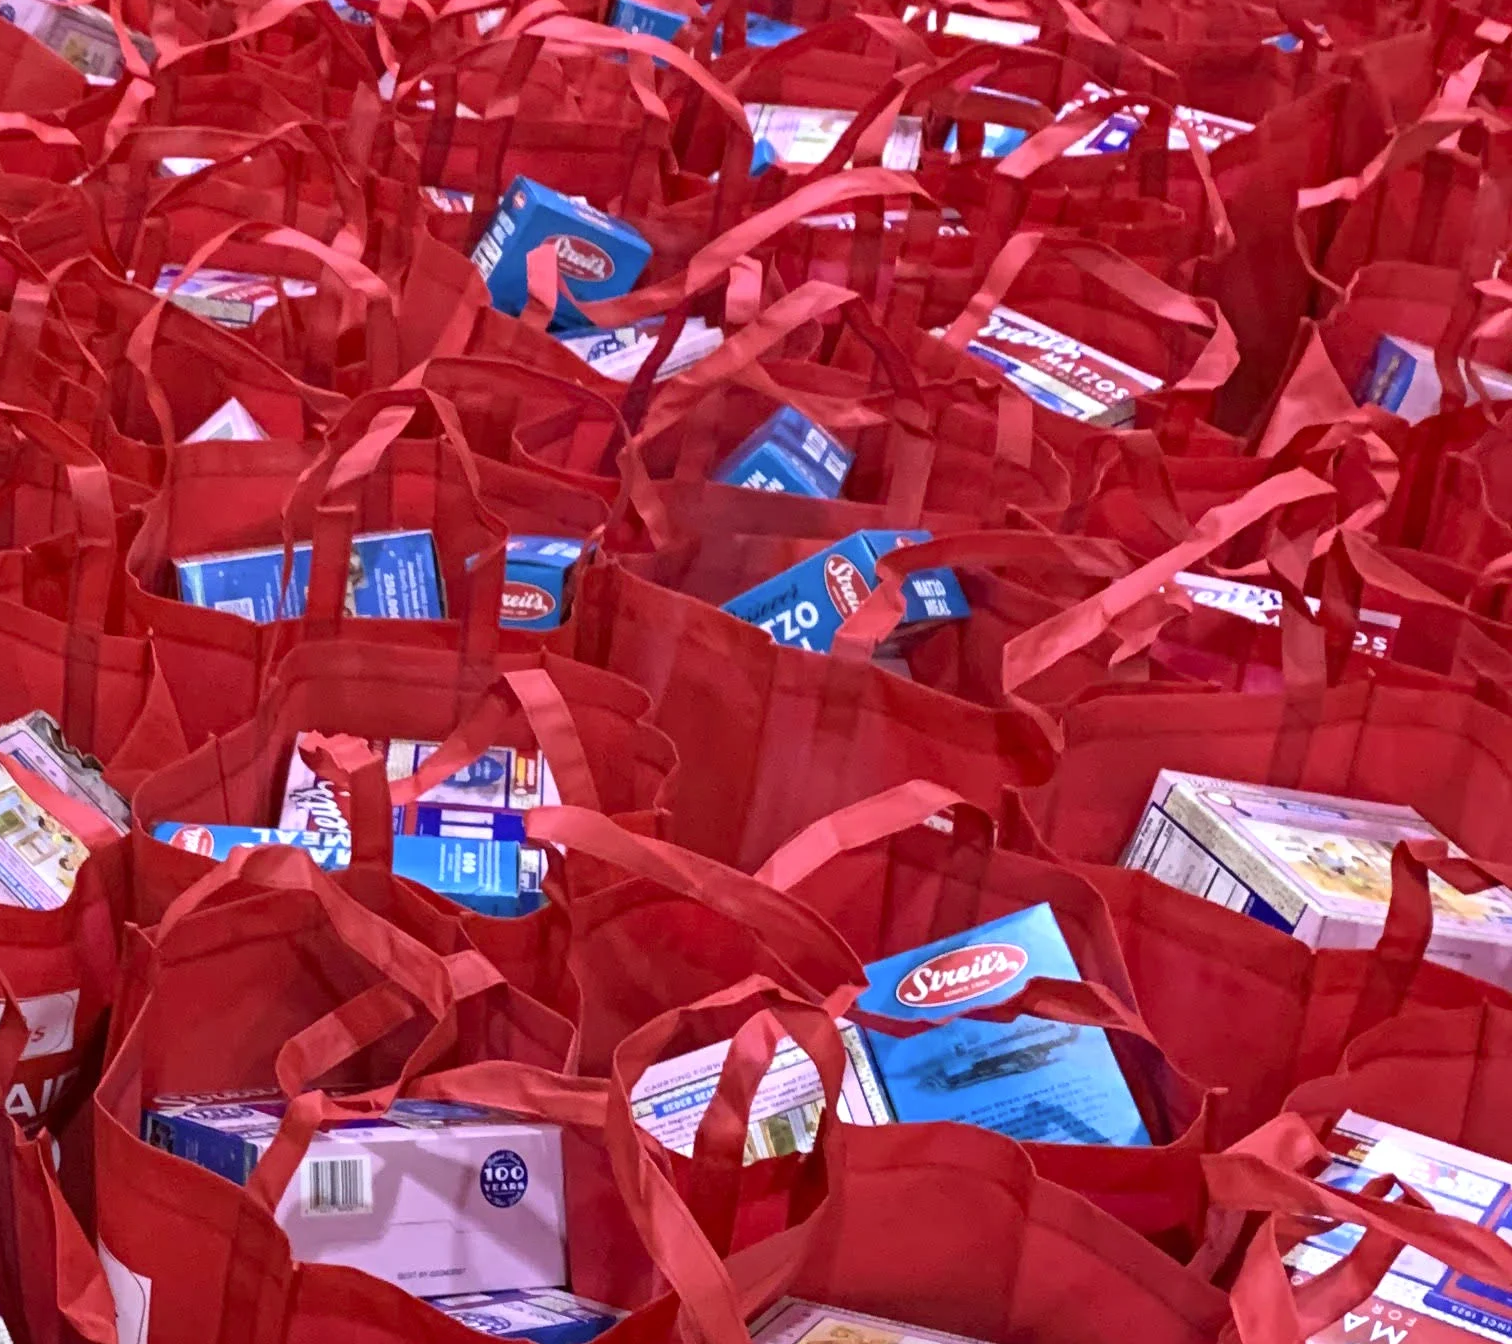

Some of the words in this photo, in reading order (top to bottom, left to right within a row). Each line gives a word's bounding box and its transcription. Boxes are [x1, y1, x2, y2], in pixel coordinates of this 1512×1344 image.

[1039, 351, 1130, 400] MATZOS
[911, 579, 947, 597] MATZO
[924, 598, 952, 617] MEAL
[904, 949, 1010, 1004] Streit's
[484, 1166, 525, 1182] 100
[484, 1182, 526, 1193] YEARS
[1370, 1302, 1417, 1328] FOR
[1478, 1313, 1512, 1335] INCE
